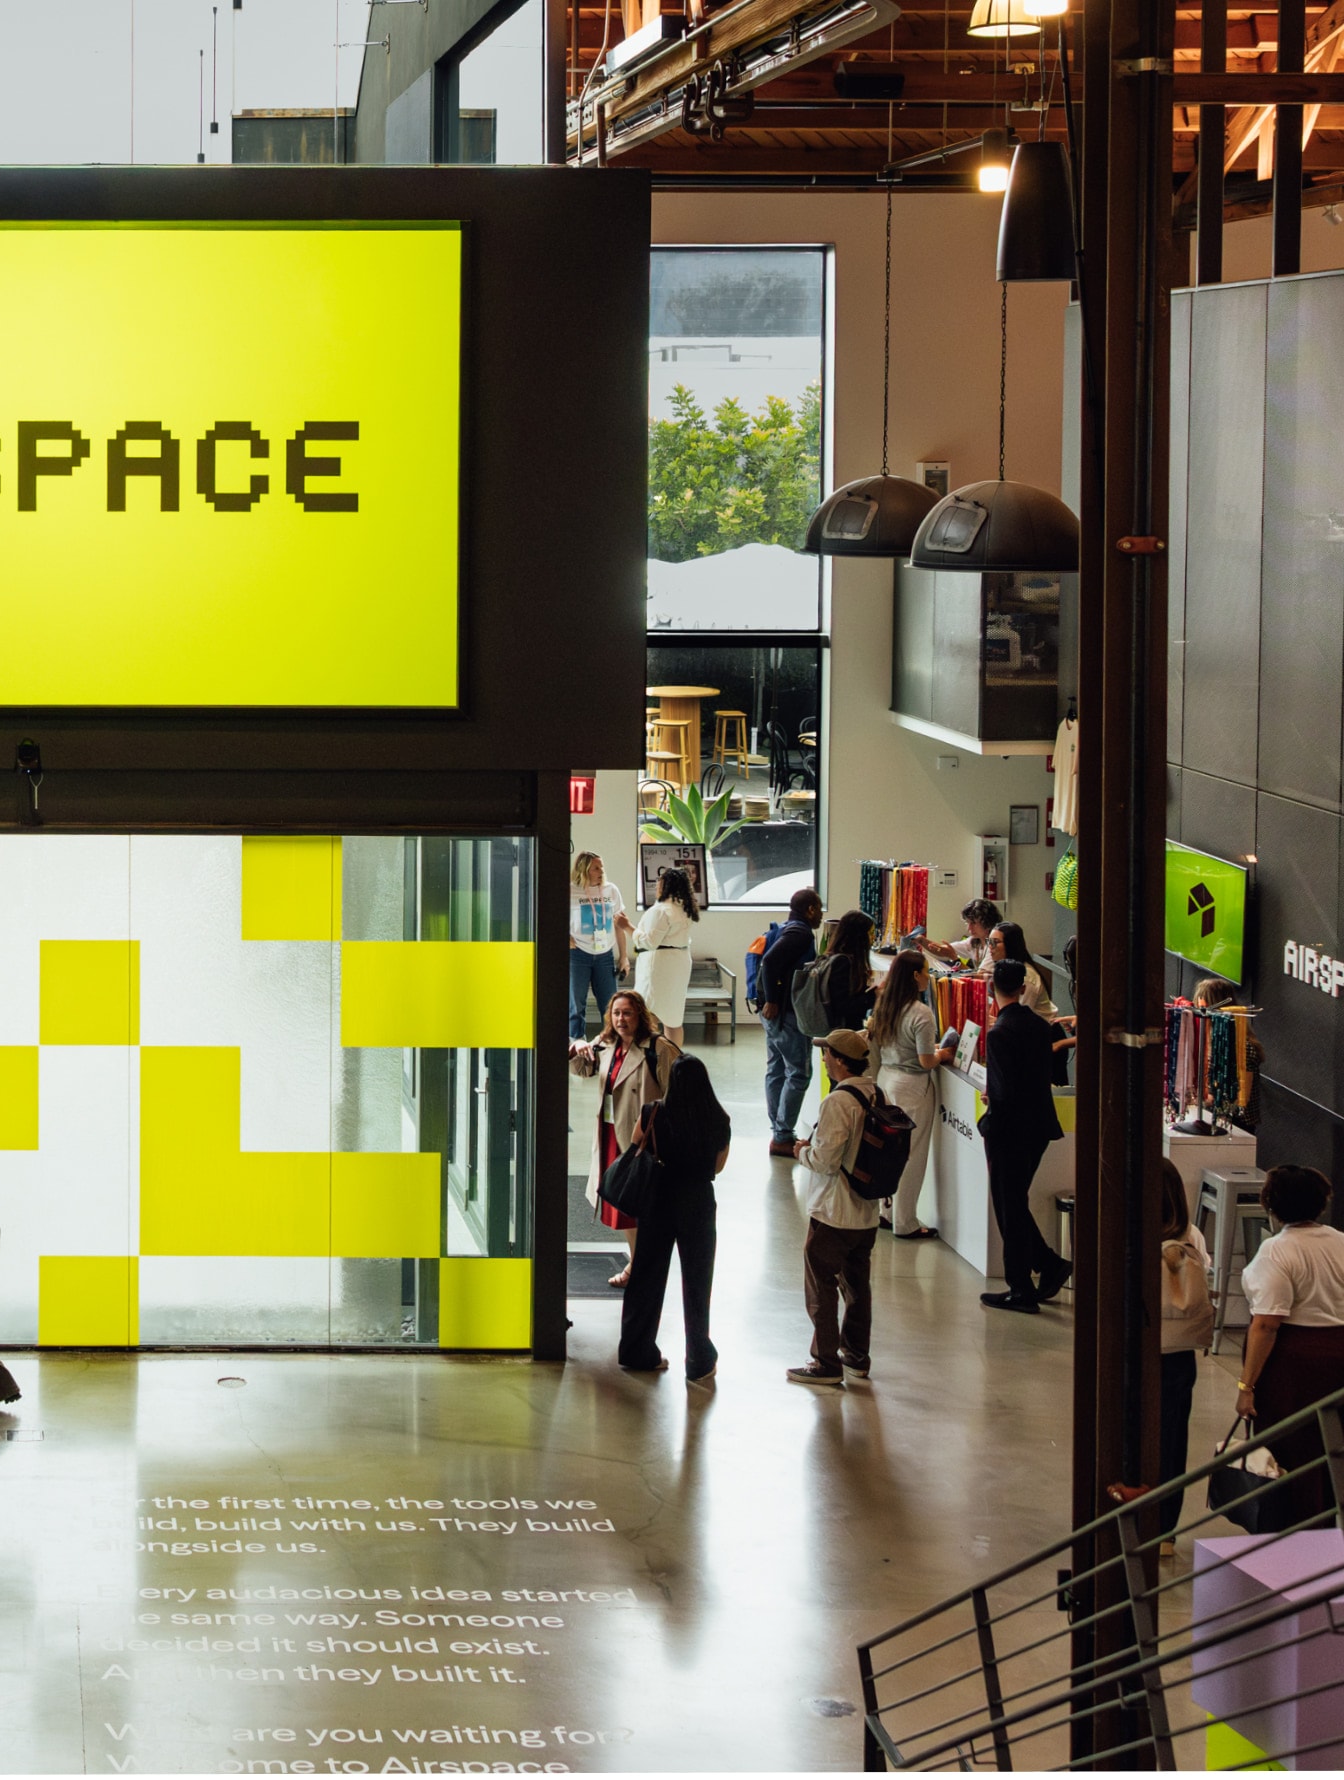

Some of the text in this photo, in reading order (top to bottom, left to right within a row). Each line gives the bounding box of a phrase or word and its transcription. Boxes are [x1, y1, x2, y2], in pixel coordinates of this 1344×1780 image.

[676, 848, 697, 859] 151
[947, 1111, 973, 1141] Airtable
[152, 1496, 210, 1510] the
[217, 1496, 286, 1510] first
[291, 1496, 381, 1512] time,
[386, 1496, 445, 1510] the
[450, 1497, 539, 1510] tools
[544, 1500, 598, 1510] we
[194, 1517, 283, 1531] build
[289, 1517, 367, 1531] with
[375, 1520, 426, 1532] us.
[428, 1518, 518, 1535] They
[525, 1518, 616, 1532] build
[275, 1542, 327, 1553] us.
[206, 1586, 403, 1600] audacious
[409, 1586, 493, 1602] idea
[500, 1588, 639, 1603] started
[170, 1612, 276, 1625] same
[284, 1613, 368, 1629] way.
[374, 1609, 566, 1629] Someone
[100, 1636, 551, 1656] decided it should exist.
[293, 1664, 383, 1686] they
[391, 1665, 483, 1683] built
[488, 1666, 527, 1684] it.
[231, 1727, 298, 1742] are
[304, 1727, 384, 1747] you
[392, 1725, 547, 1748] waiting
[324, 1757, 370, 1774] to
[378, 1756, 571, 1774] Airspace
